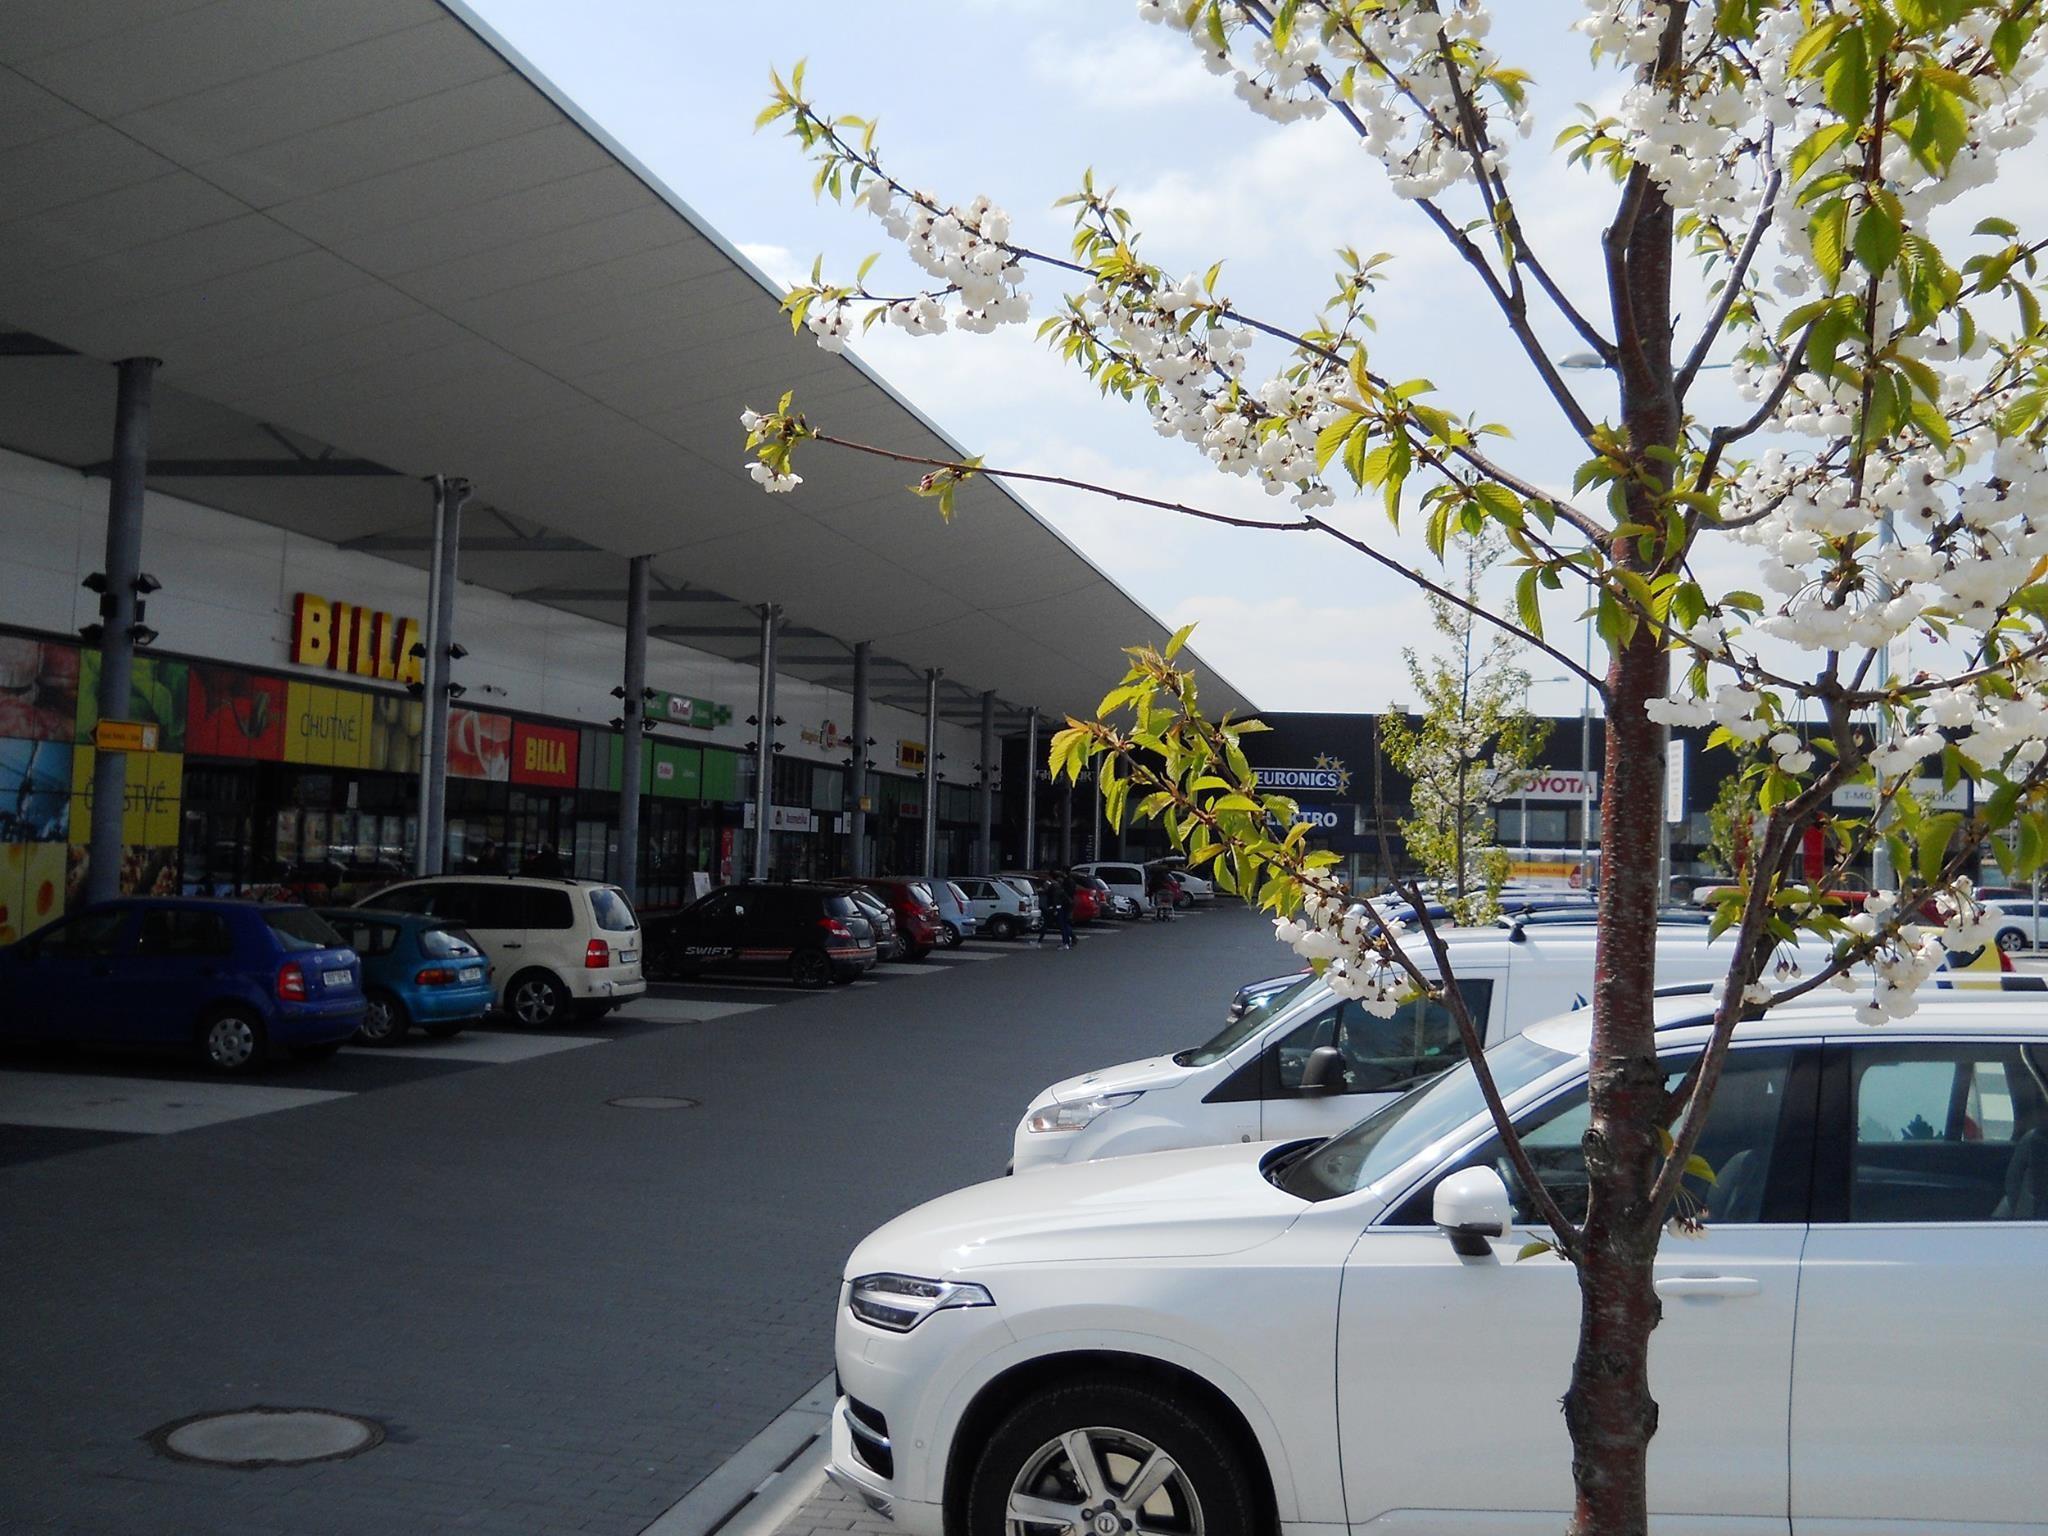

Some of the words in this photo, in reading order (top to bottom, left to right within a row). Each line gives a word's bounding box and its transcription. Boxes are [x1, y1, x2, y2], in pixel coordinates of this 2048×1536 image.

[291, 592, 423, 683] BILLA
[300, 713, 357, 742] CHUTNÉ
[525, 736, 567, 774] BILLA
[1256, 771, 1338, 787] EURONICS
[685, 946, 733, 956] SWIFT
